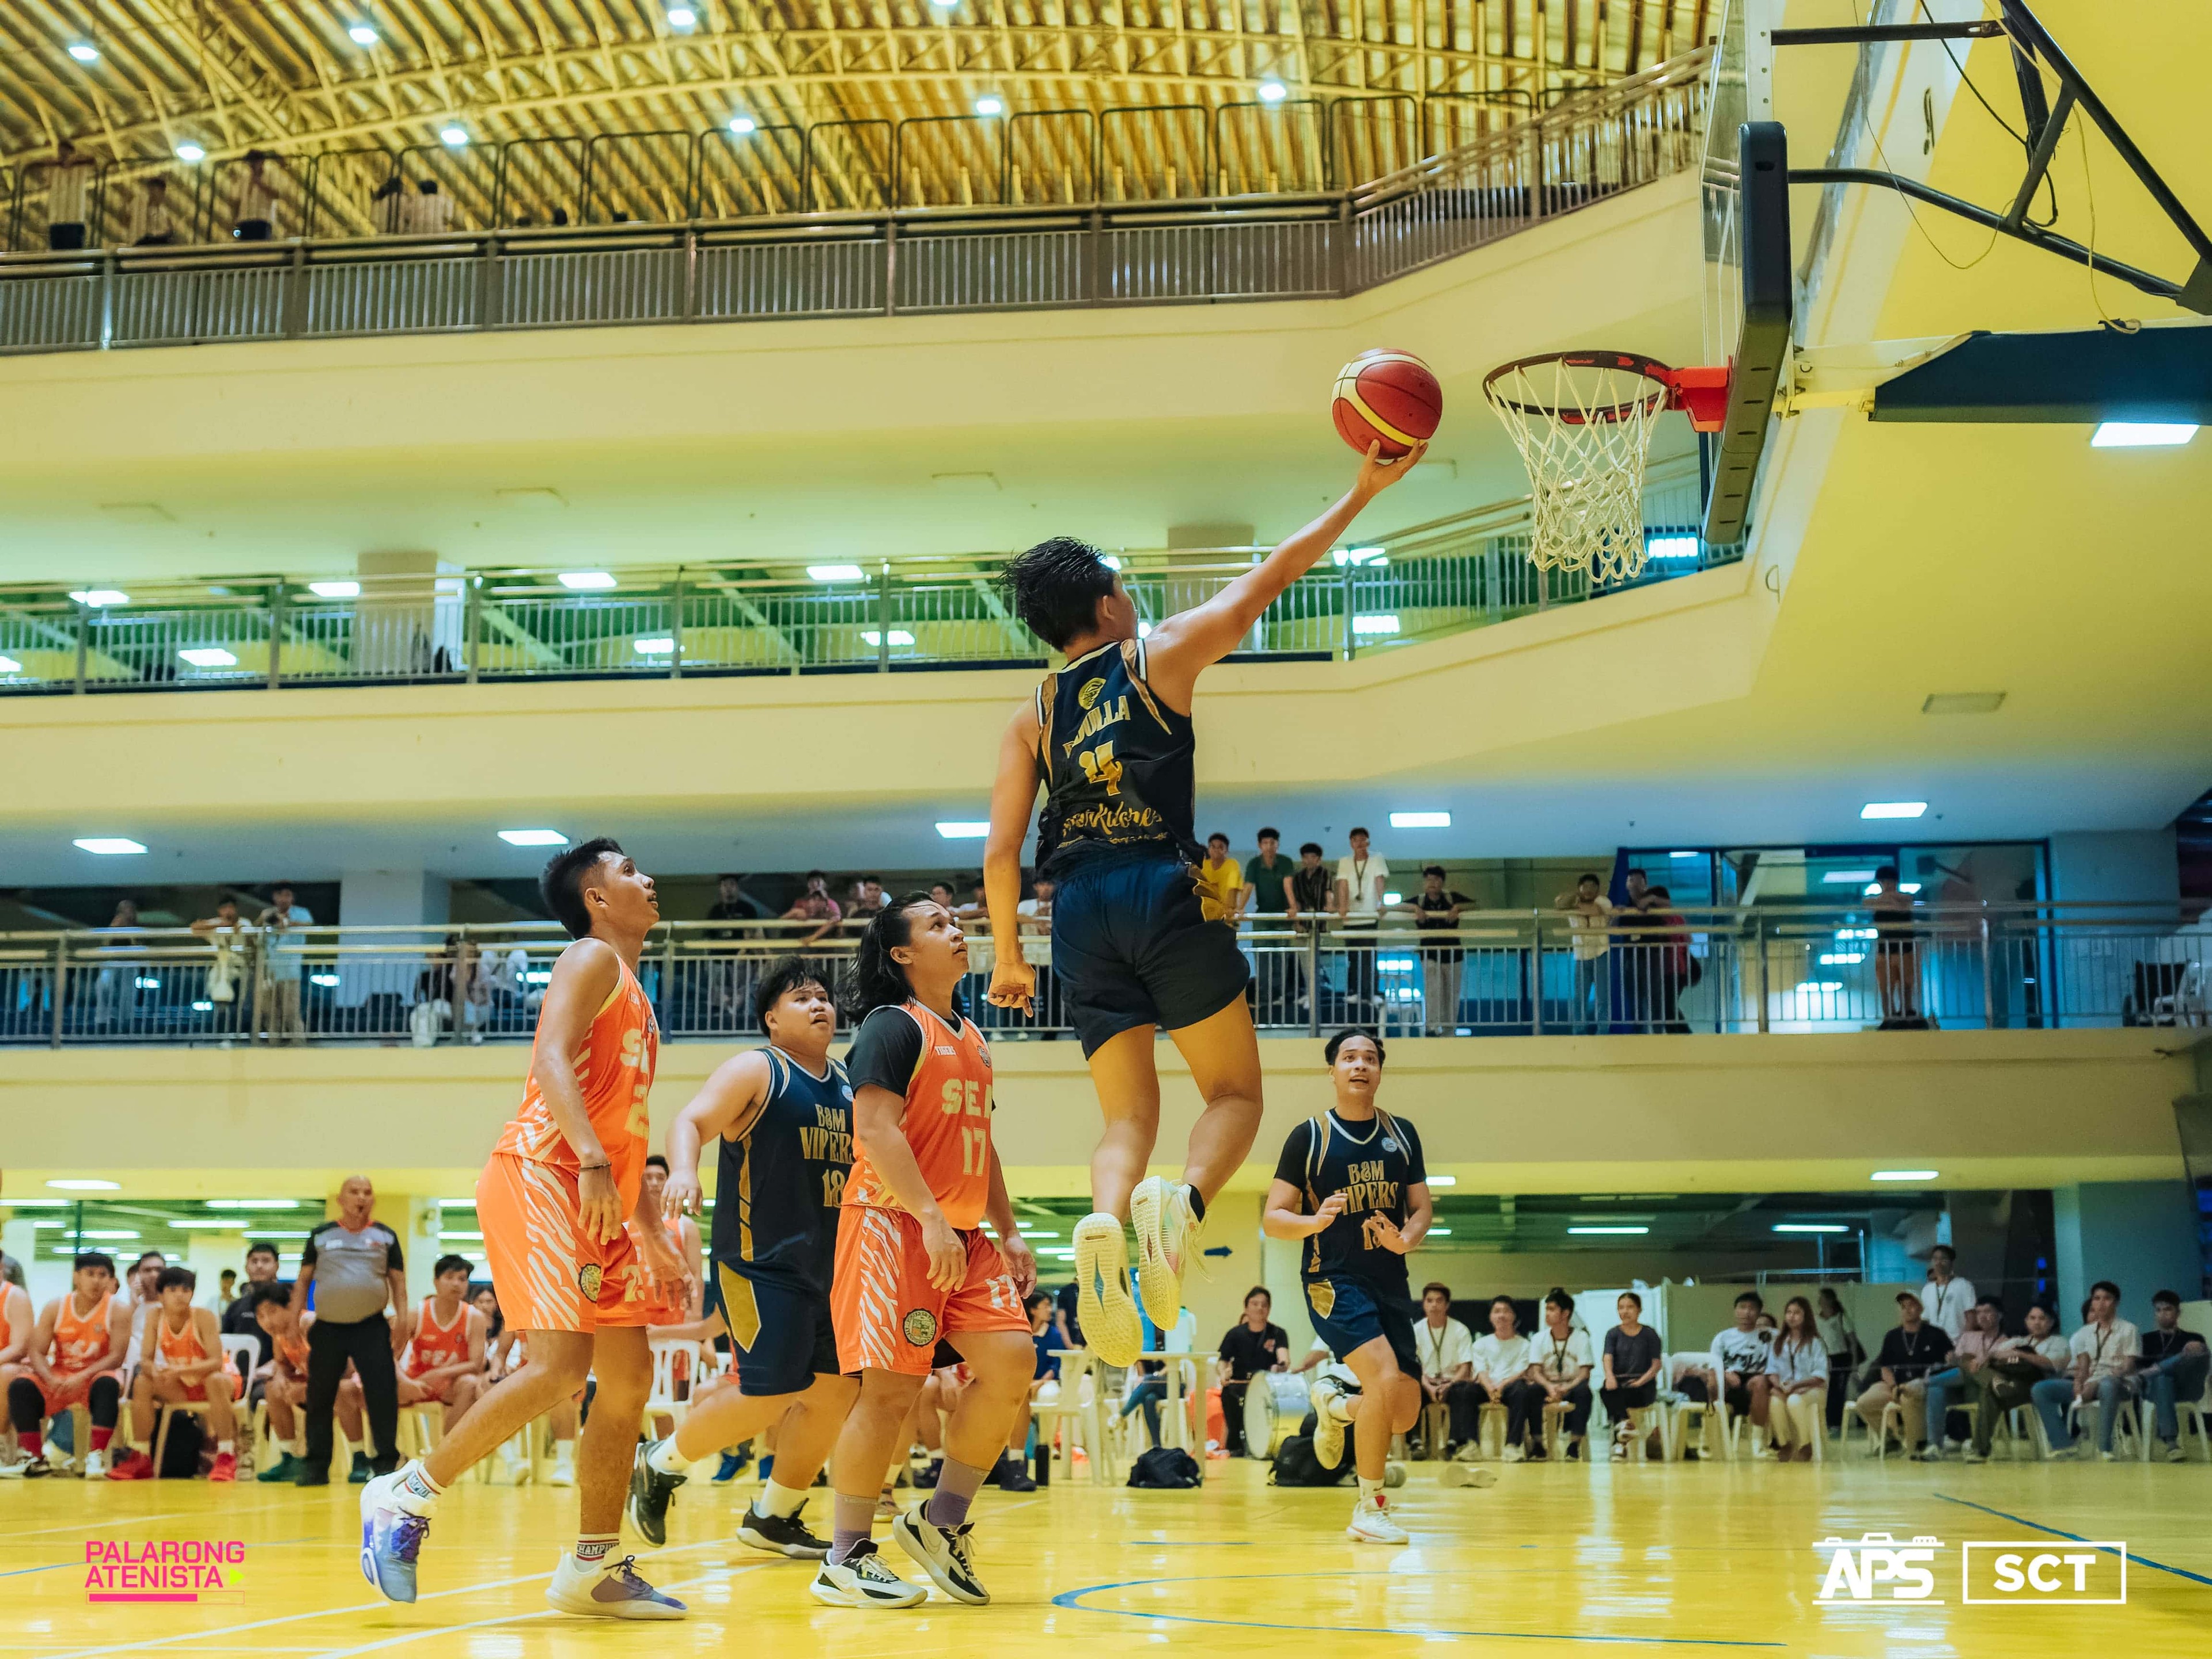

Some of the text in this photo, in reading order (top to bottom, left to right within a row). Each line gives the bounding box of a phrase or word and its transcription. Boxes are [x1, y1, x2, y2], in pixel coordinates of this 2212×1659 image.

[815, 1104, 846, 1132] B&M
[961, 1126, 986, 1176] 17
[822, 1169, 845, 1208] 18
[1347, 1160, 1385, 1184] B&M
[984, 1274, 1018, 1308] 17
